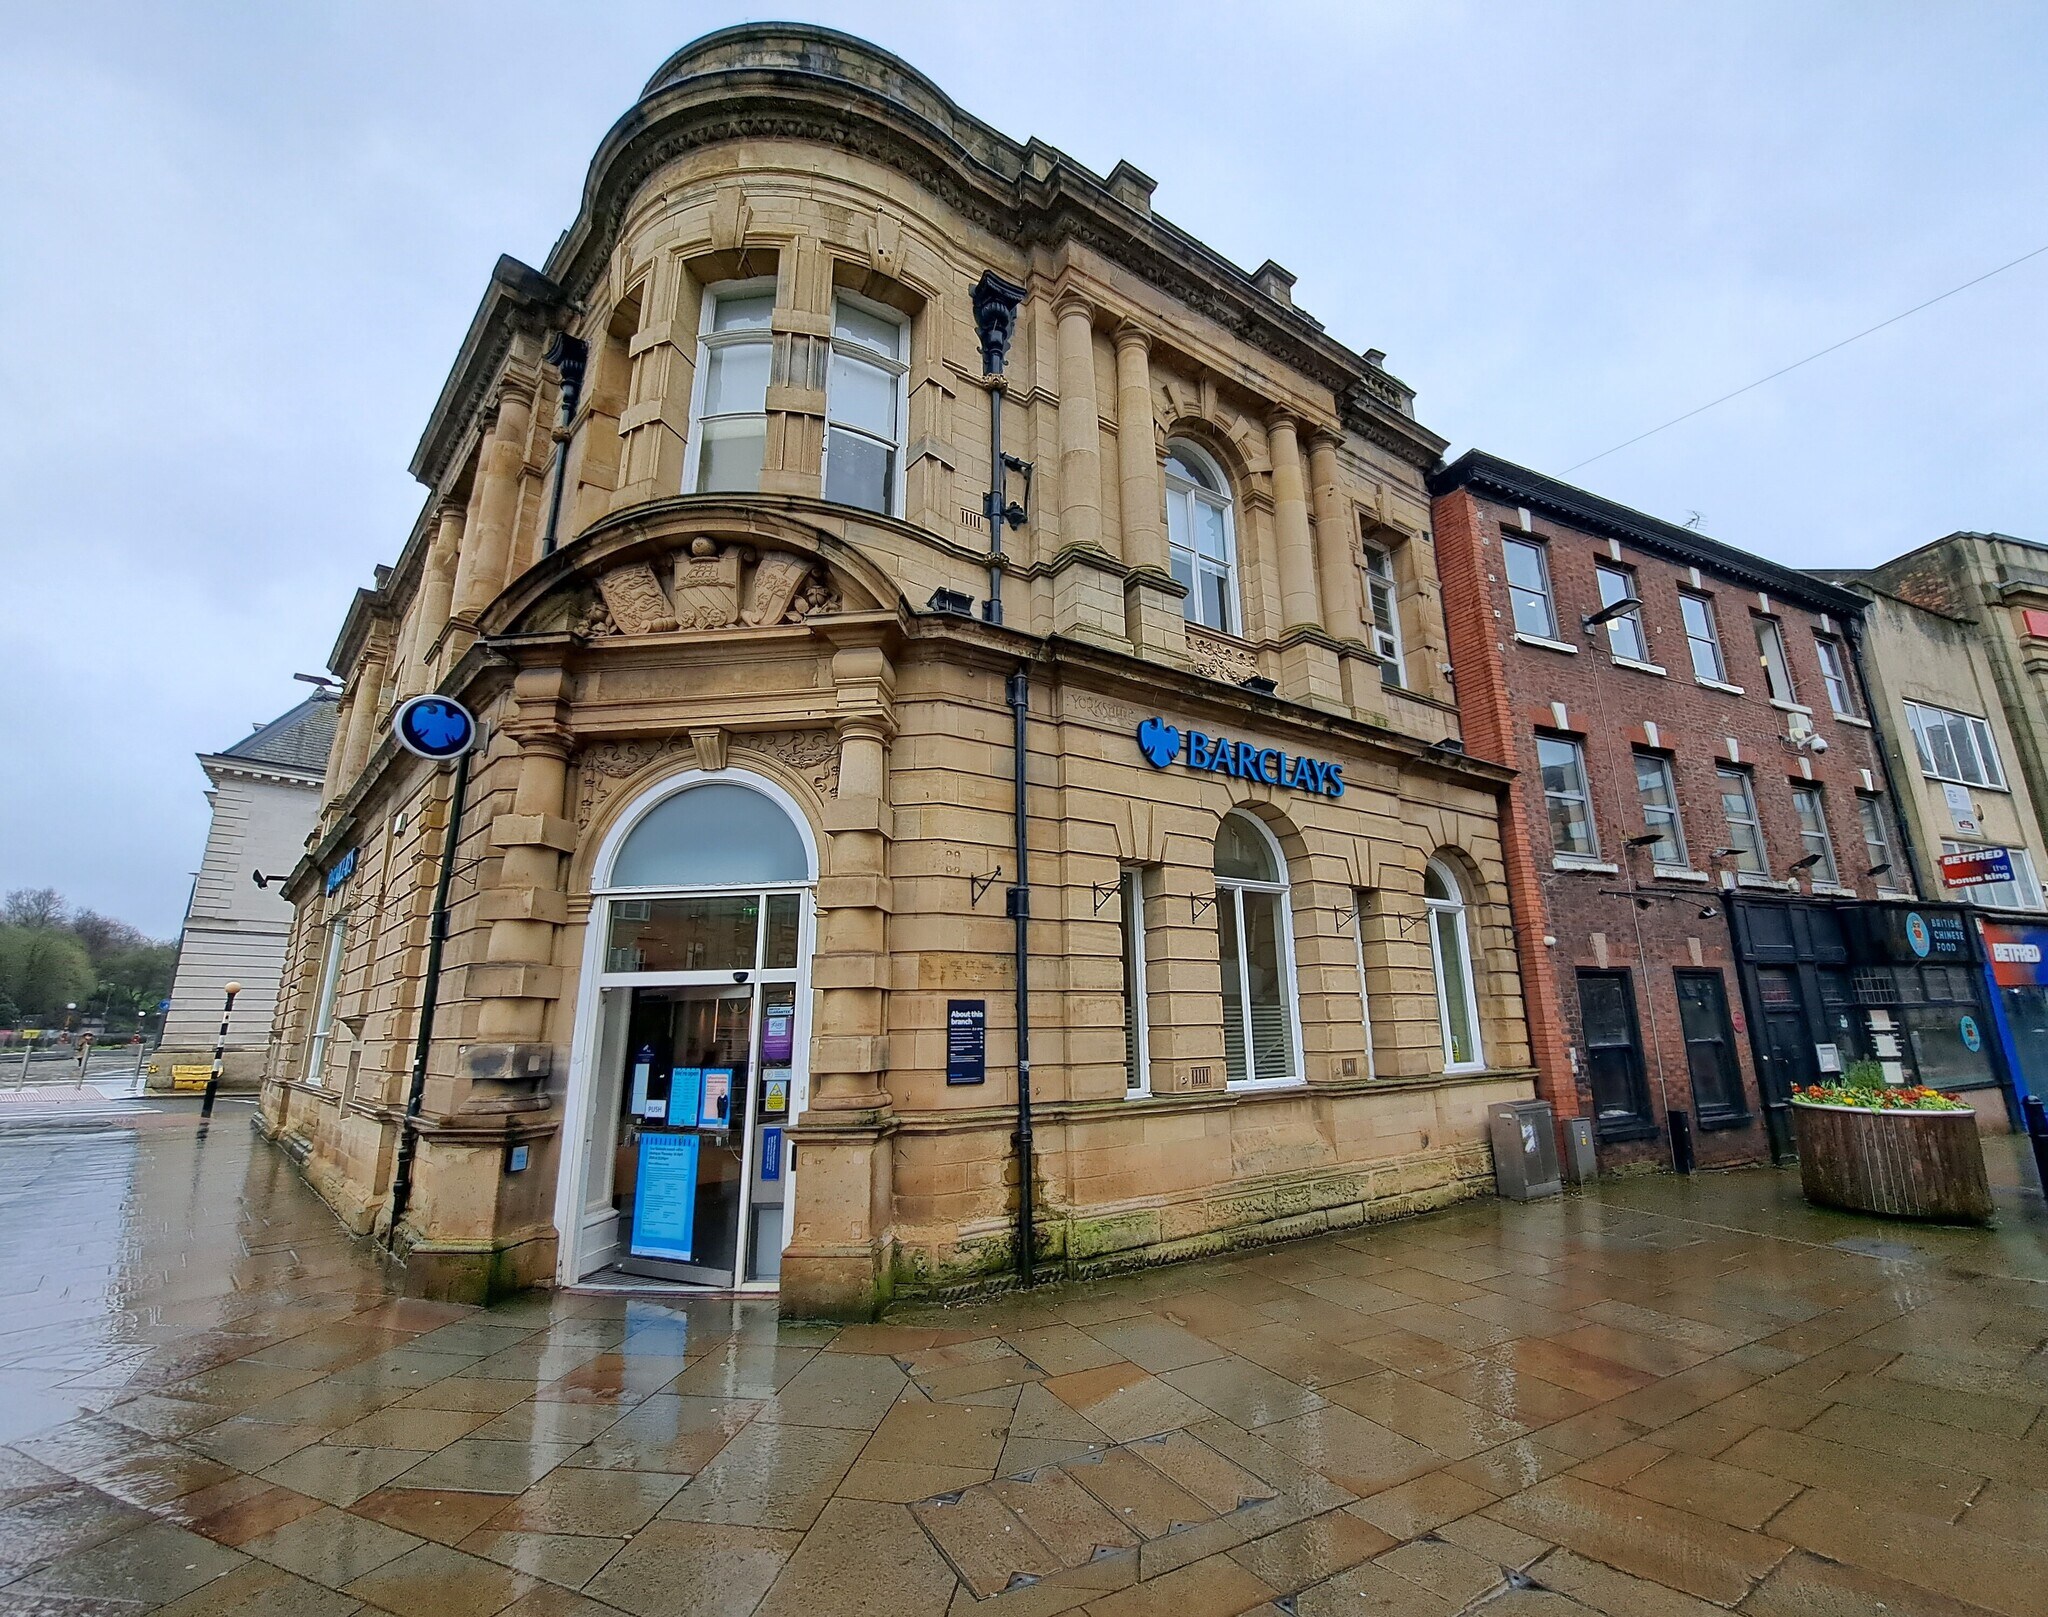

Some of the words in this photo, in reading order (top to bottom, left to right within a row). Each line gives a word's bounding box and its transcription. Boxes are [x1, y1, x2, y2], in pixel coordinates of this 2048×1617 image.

[1186, 730, 1345, 797] BARCLAYS
[1944, 850, 2004, 865] BETFRED
[1949, 875, 1983, 885] bonus
[1934, 930, 1965, 940] CHINESE
[1936, 942, 1957, 952] FOOD
[1993, 943, 2040, 962] BETFRED
[647, 1105, 662, 1113] PUSH
